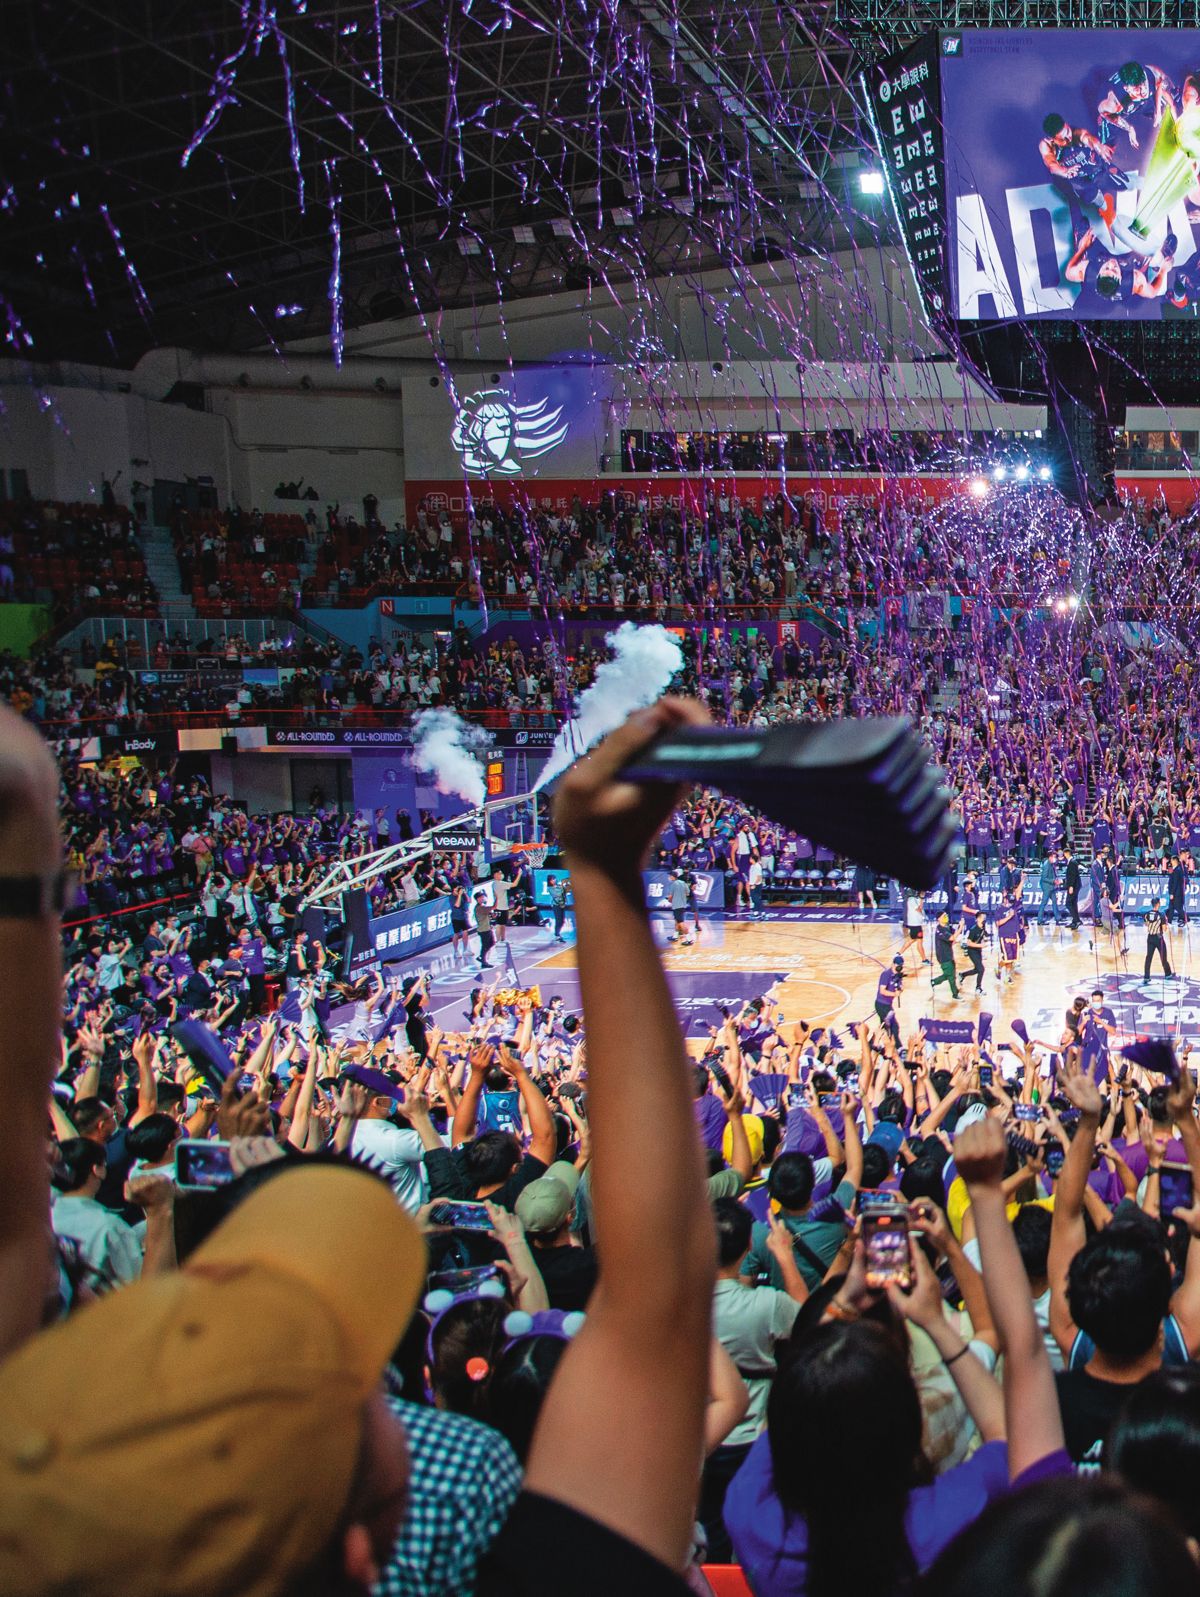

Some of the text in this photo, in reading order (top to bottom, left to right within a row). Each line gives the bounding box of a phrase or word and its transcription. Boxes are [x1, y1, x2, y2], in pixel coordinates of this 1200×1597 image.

[382, 600, 393, 612] N
[287, 732, 335, 742] ALL-ROUNDED
[354, 732, 403, 742] ALL-ROUNDED
[125, 739, 156, 751] InBody
[1128, 883, 1159, 895] NEW
[375, 922, 422, 950] 專業貼布
